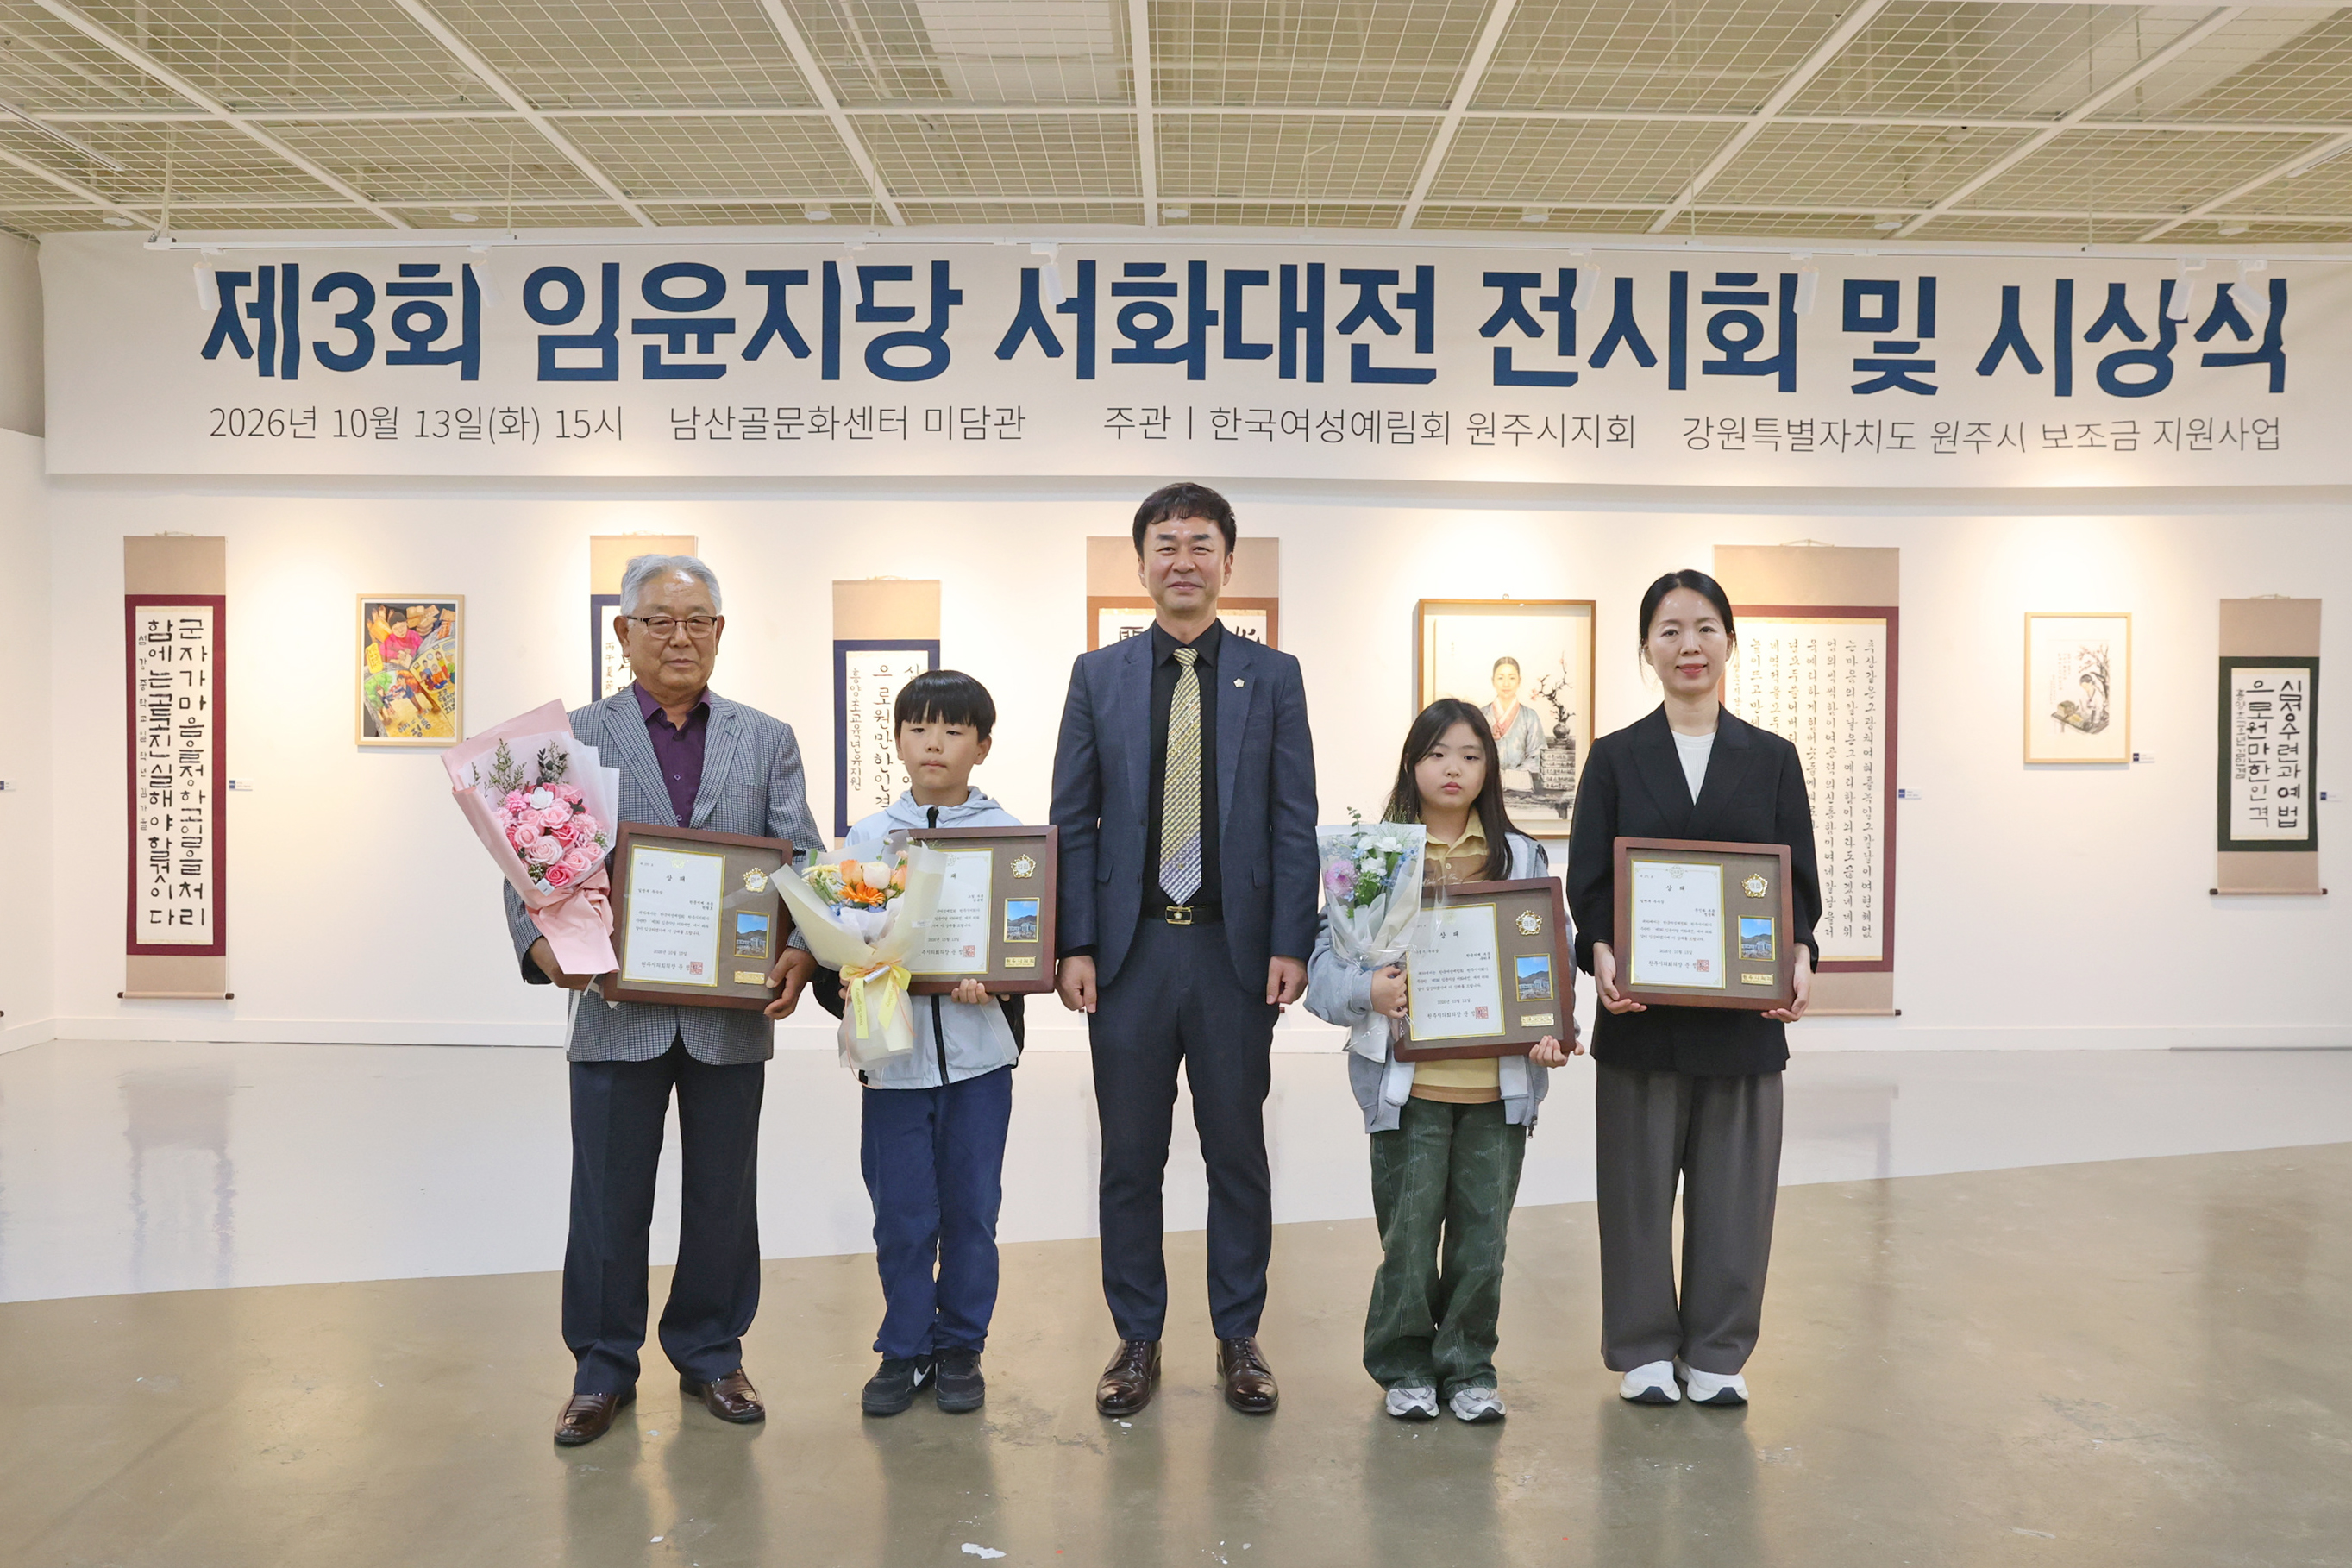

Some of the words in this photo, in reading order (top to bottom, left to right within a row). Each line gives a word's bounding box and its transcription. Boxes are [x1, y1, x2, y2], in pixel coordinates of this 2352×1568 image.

[201, 263, 480, 380] 제3회
[524, 262, 962, 381] 임윤지당
[994, 260, 1436, 384] 서화대전
[1479, 269, 1797, 392] 전시회
[1844, 277, 1937, 395] 및
[1975, 279, 2287, 398] 시상식
[210, 405, 317, 440] 2026년
[333, 406, 398, 440] 10월
[415, 405, 540, 446] 13일(화)
[555, 405, 623, 441] 15시
[670, 405, 907, 441] 남산골문화센터
[925, 405, 1026, 441] 미담관
[1104, 405, 1171, 441] 주관
[1209, 405, 1451, 446] 한국여성예림회
[1466, 411, 1635, 449] 원주시지회
[1683, 416, 1916, 454] 강원특별자치도
[1930, 420, 2026, 455] 원주시
[2042, 420, 2142, 452] 보조금
[2153, 417, 2280, 452] 지원사업
